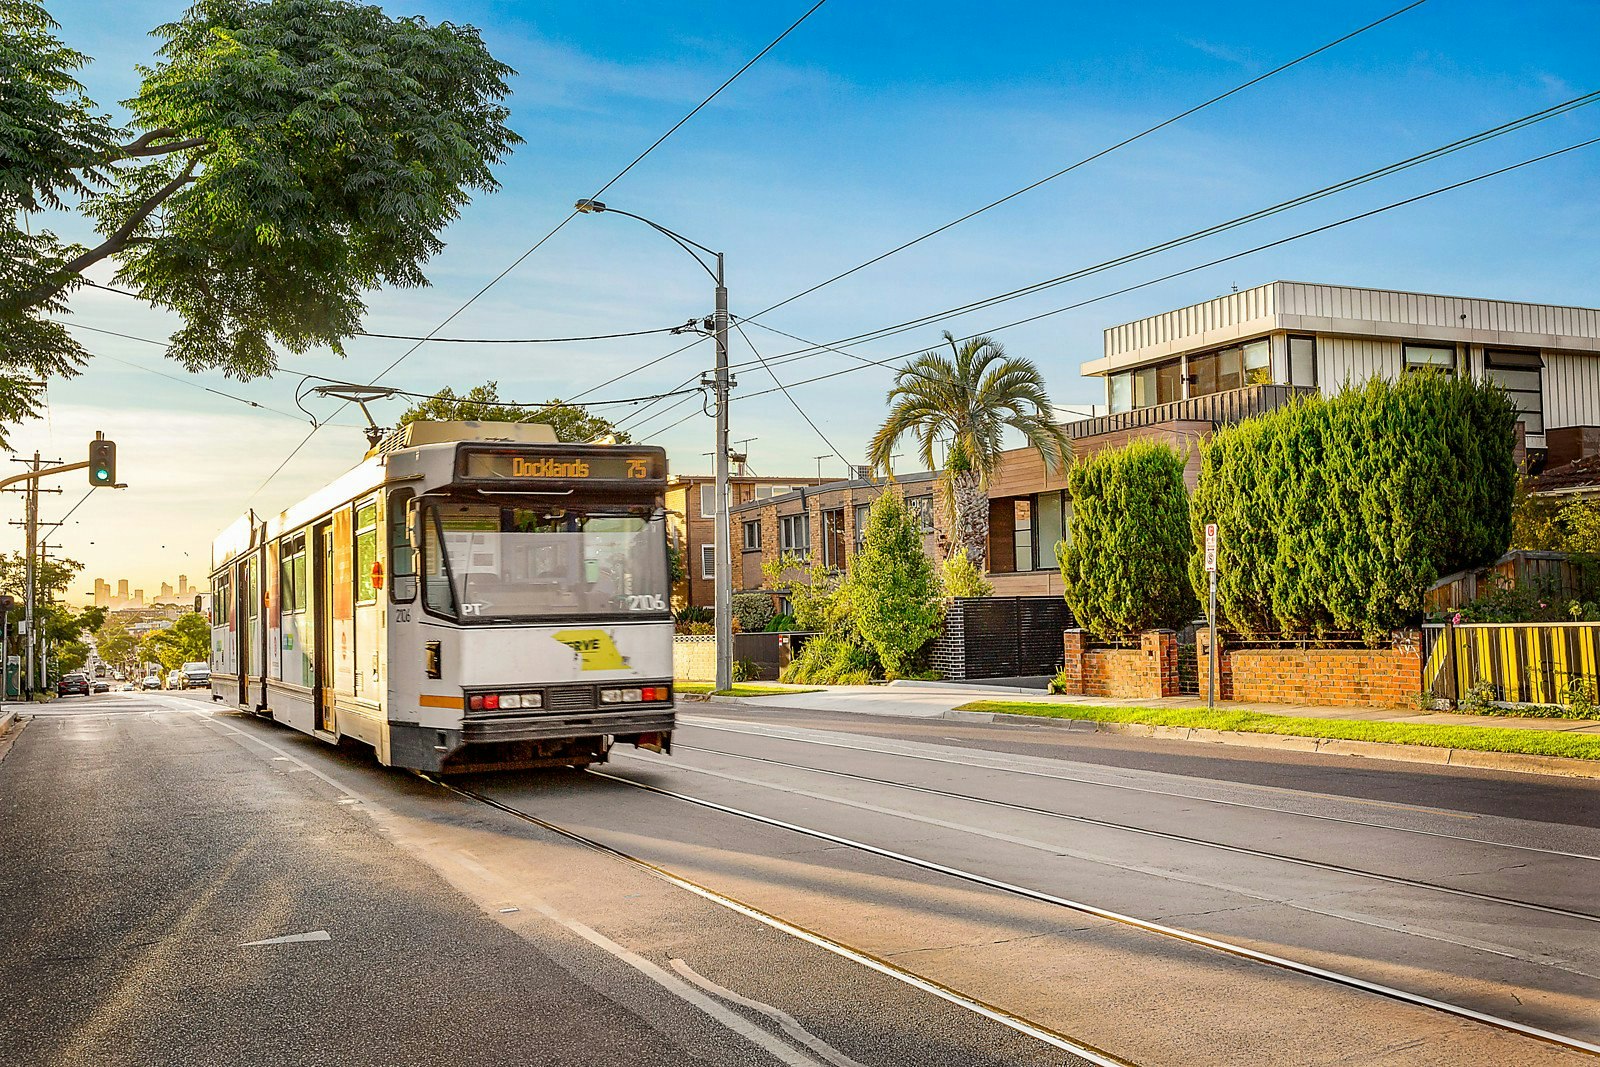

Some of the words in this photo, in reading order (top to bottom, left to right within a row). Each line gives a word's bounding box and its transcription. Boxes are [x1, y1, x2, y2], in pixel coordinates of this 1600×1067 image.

[512, 457, 590, 478] Docklands
[625, 459, 648, 479] 75
[461, 603, 482, 616] PT
[629, 593, 667, 611] 2106
